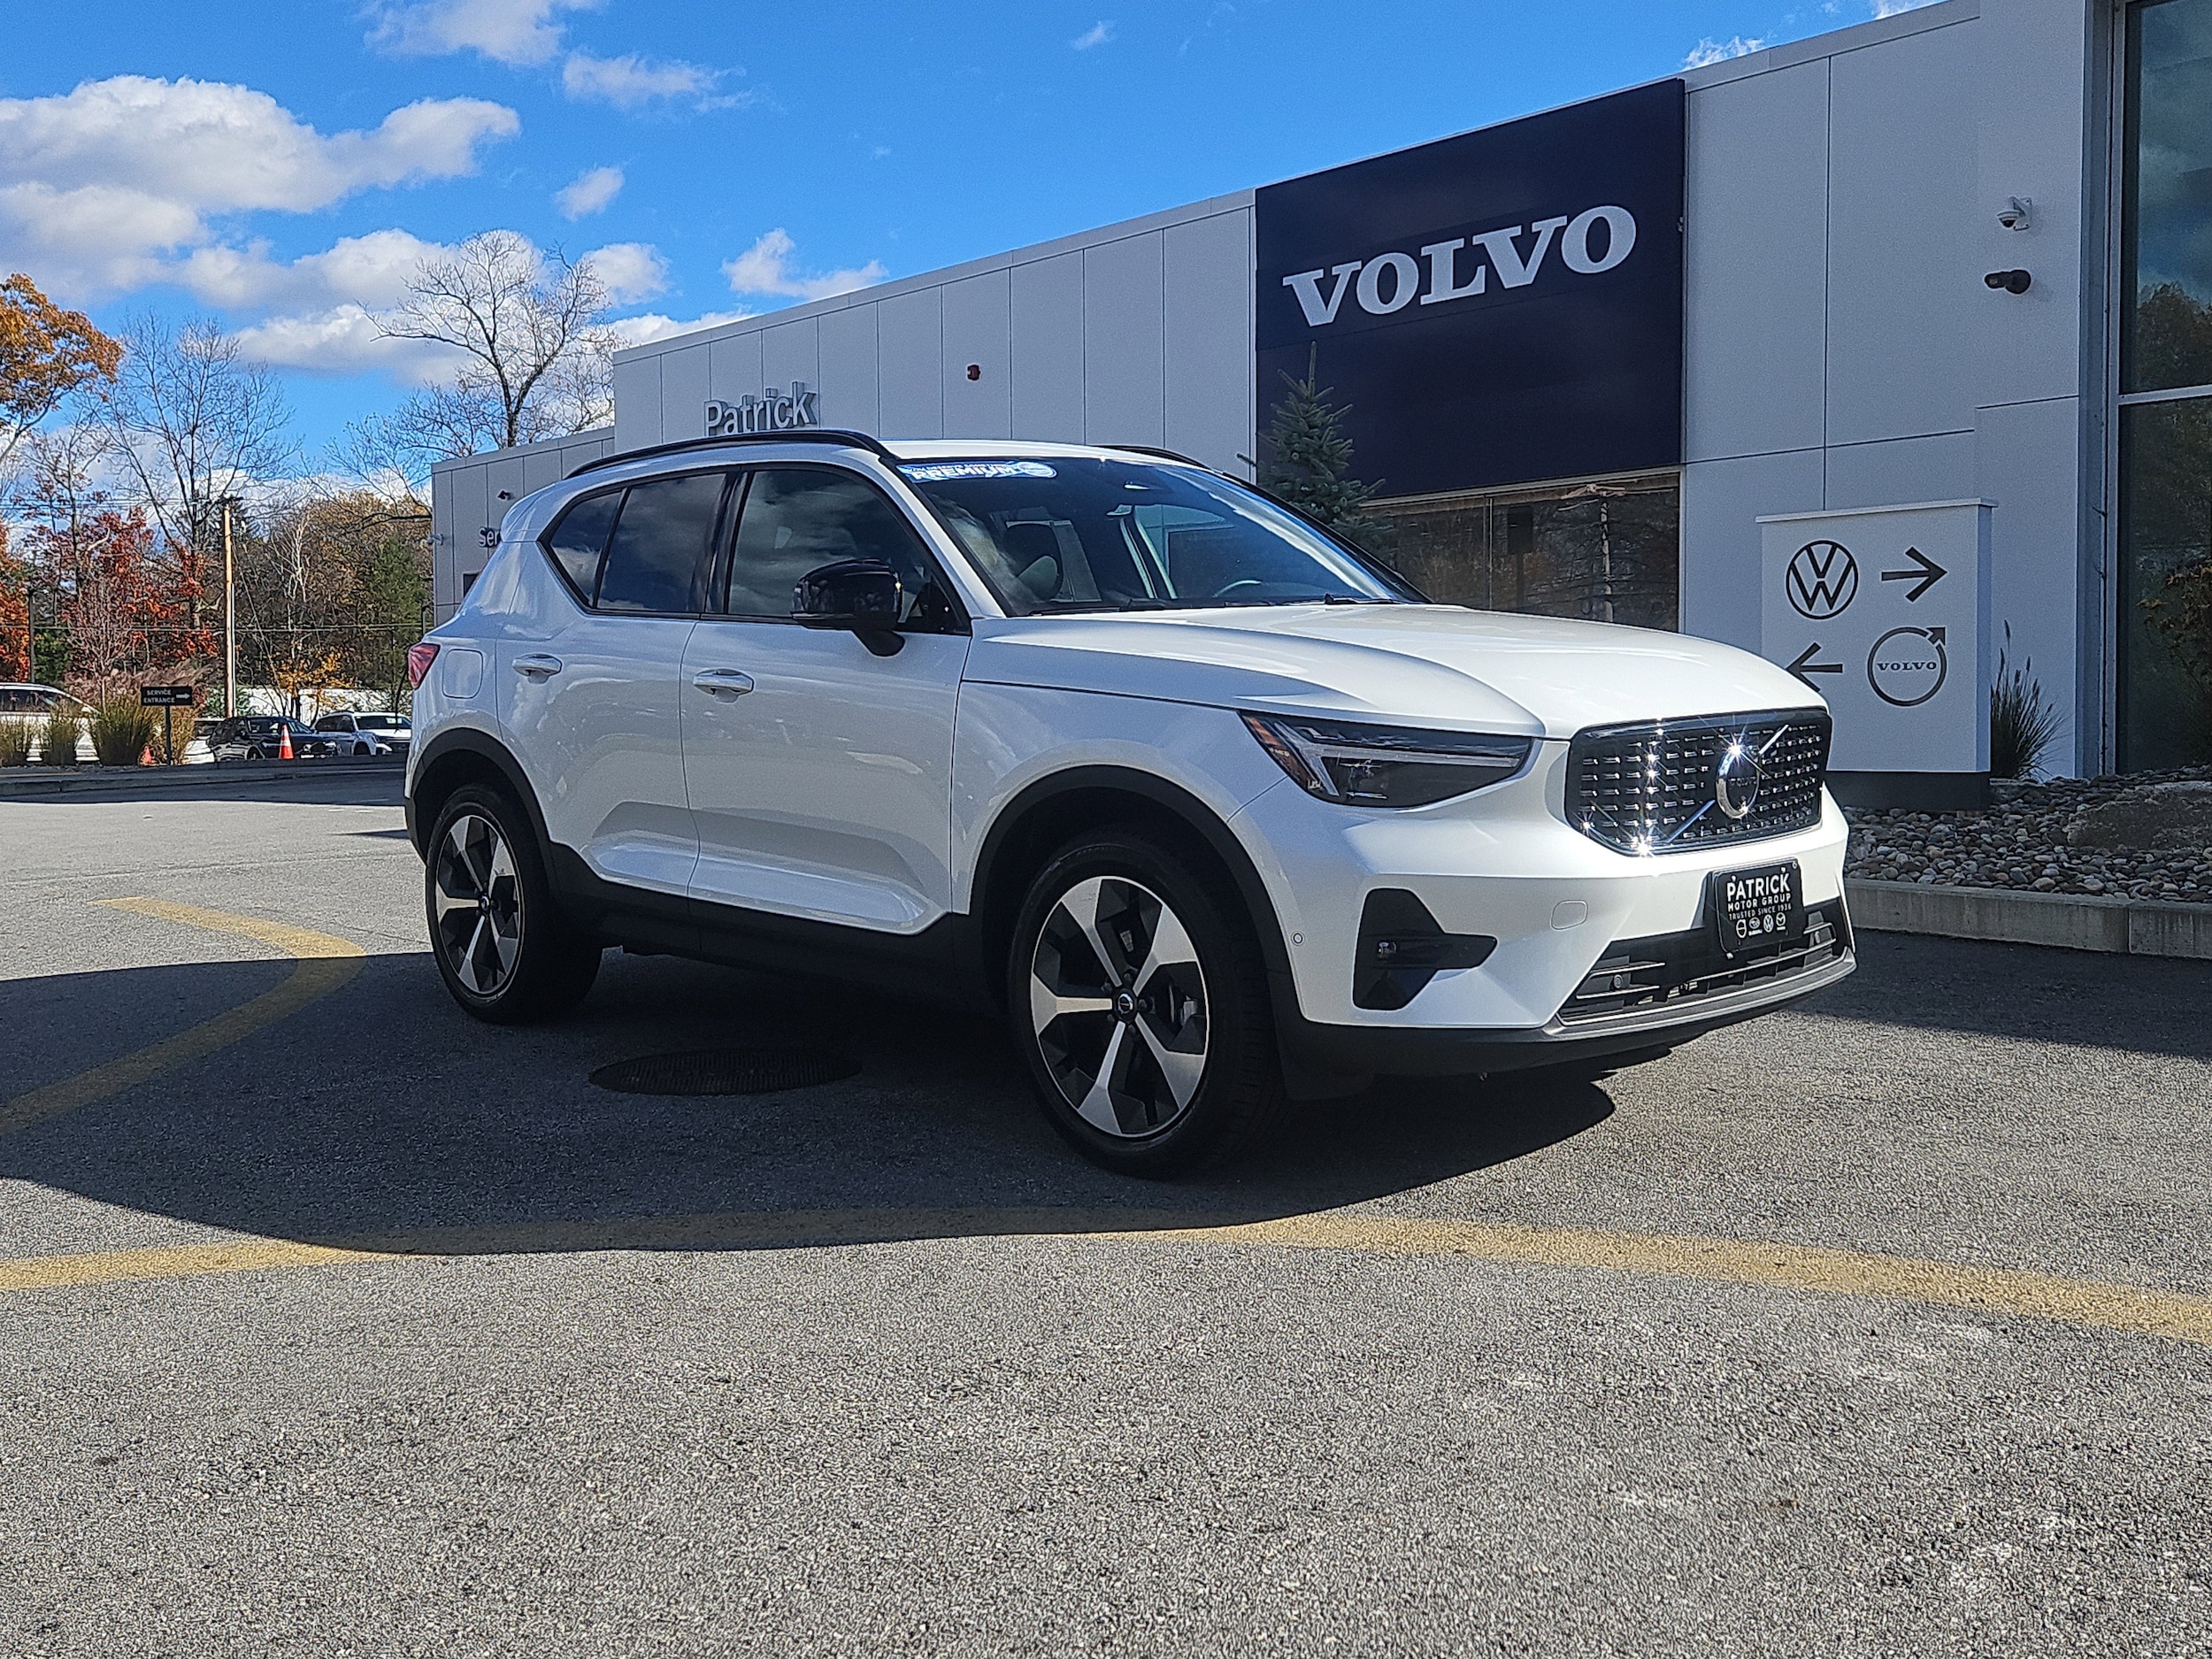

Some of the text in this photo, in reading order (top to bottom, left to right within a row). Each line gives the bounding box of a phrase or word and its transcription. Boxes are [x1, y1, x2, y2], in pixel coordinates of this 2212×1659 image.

[1282, 204, 1636, 326] VOLVO
[704, 381, 815, 436] Patrick
[911, 465, 1017, 480] PREMIUM
[1877, 661, 1937, 671] VOLVO
[1726, 873, 1791, 902] PATRICK
[1728, 894, 1791, 912] MOTOR GROUP
[1729, 910, 1756, 920] TRUSTED
[1758, 905, 1776, 916] SINCE
